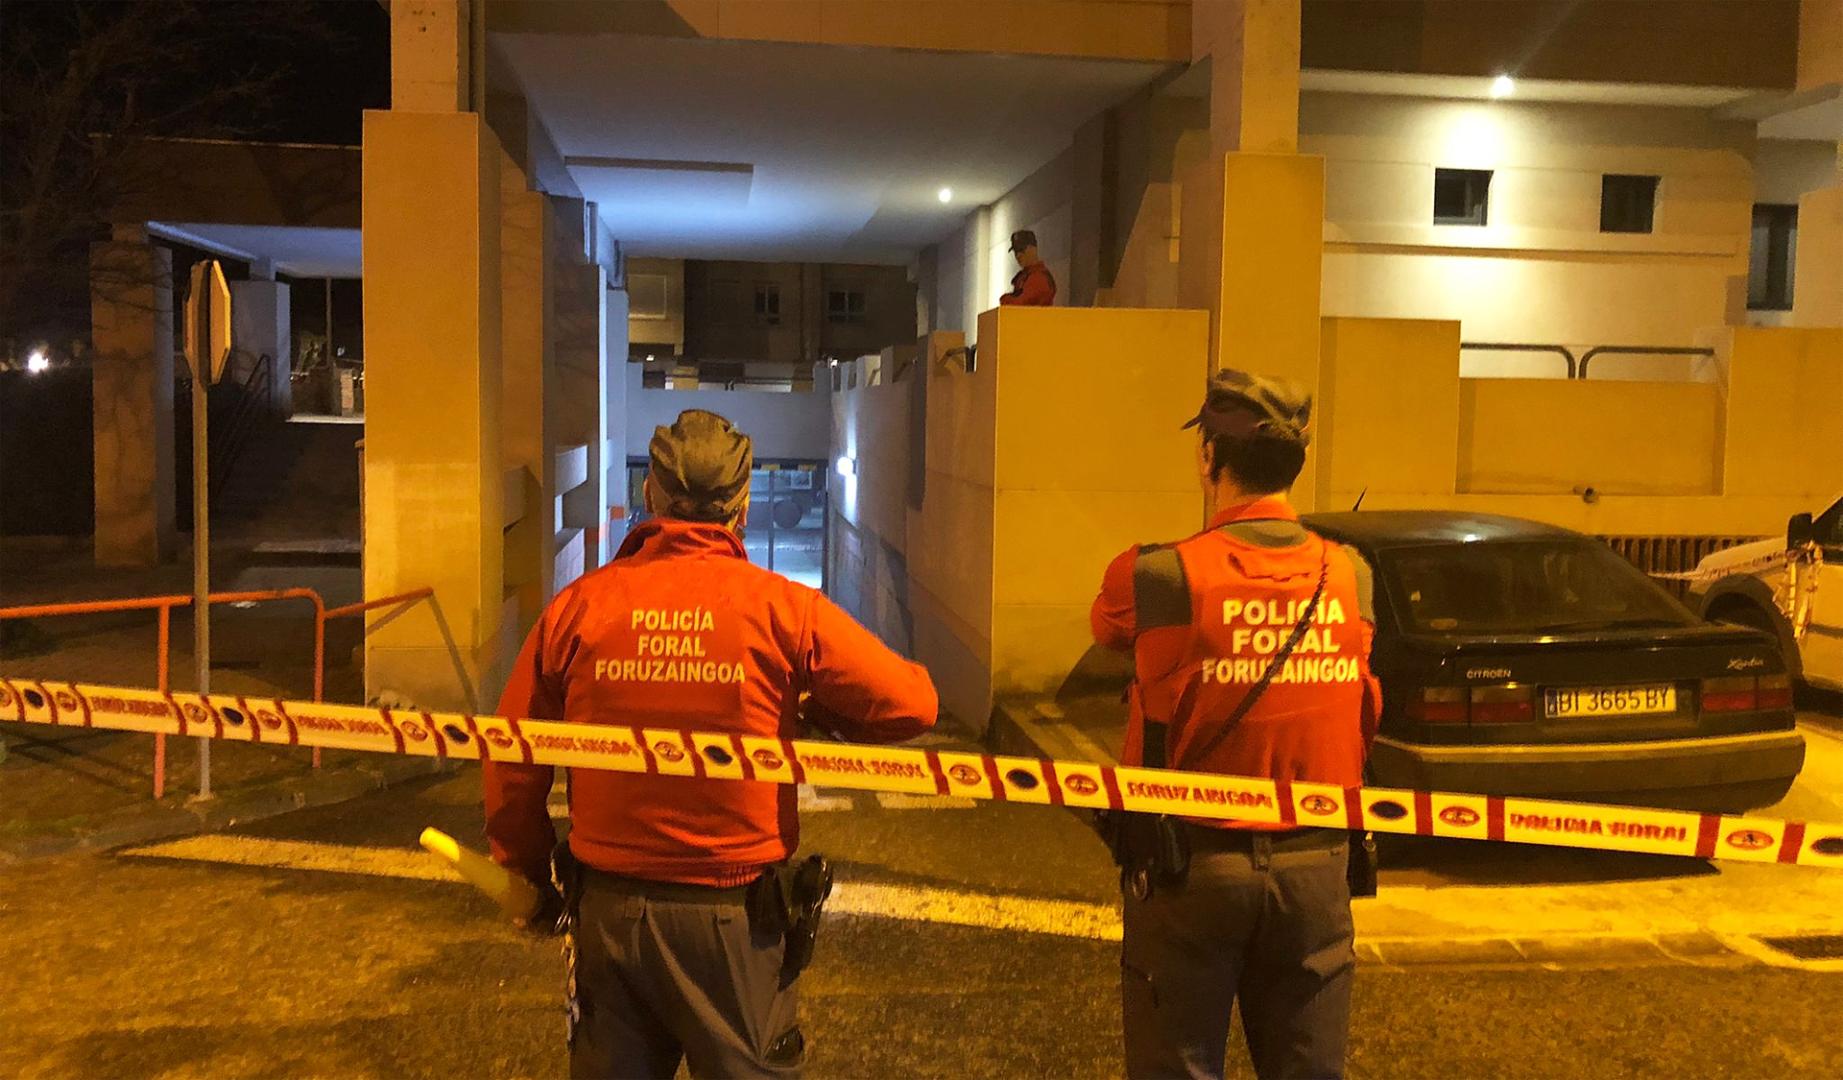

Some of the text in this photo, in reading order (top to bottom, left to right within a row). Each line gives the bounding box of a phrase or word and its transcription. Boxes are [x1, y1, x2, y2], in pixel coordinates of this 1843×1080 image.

[631, 605, 715, 632] POLICÍA
[1222, 592, 1345, 626] POLICÍA
[638, 634, 706, 658] FORAL
[1232, 627, 1341, 655] FORAL
[595, 658, 745, 684] FORUZAINGOA
[1587, 688, 1641, 711] 3665
[1646, 686, 1669, 709] BY
